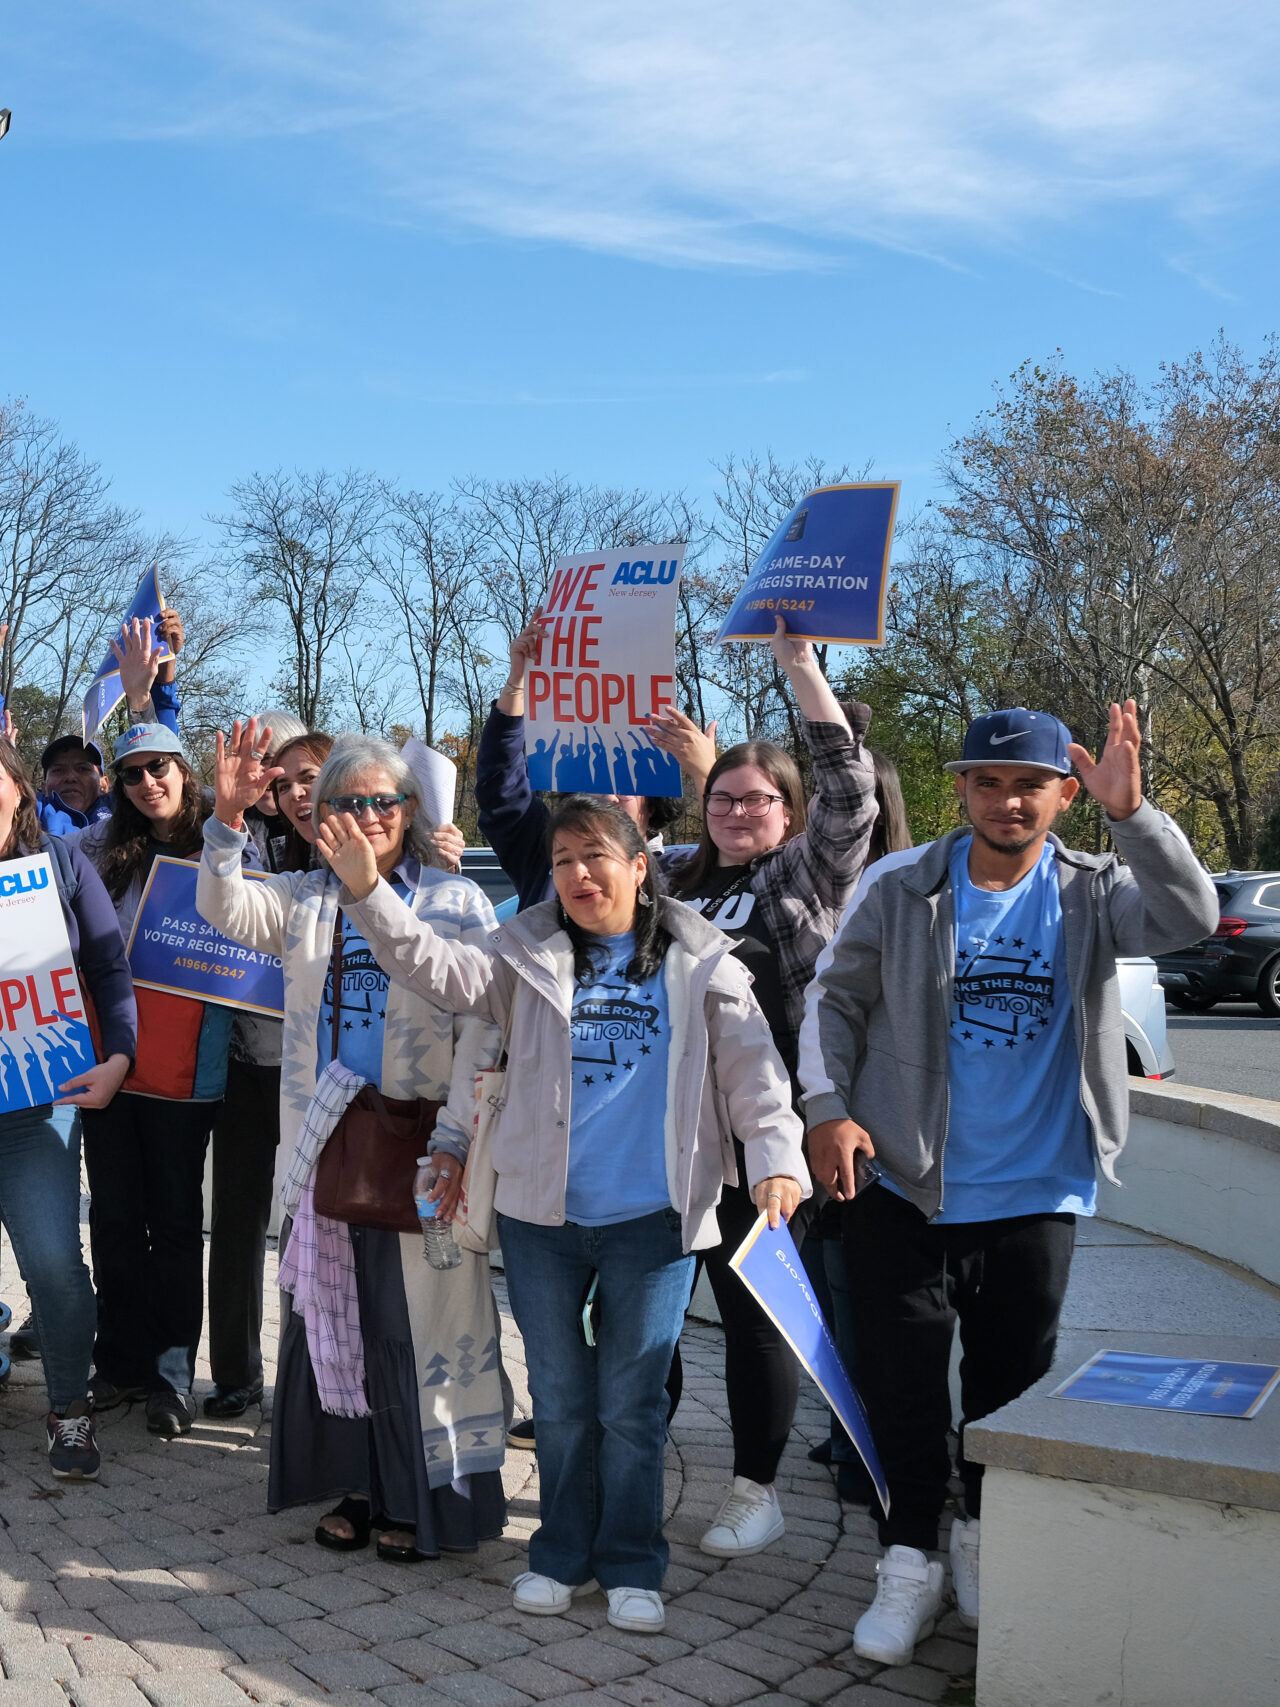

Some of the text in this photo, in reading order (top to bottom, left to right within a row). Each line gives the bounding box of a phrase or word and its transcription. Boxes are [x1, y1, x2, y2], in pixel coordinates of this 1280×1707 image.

[768, 555, 846, 571] SAME-DAY
[611, 560, 678, 586] ACLU
[757, 574, 869, 590] REGISTRATION
[546, 563, 606, 613] WE
[608, 587, 658, 598] New Jersey
[745, 598, 816, 612] A1966/S247
[534, 616, 603, 668] THE
[529, 670, 673, 726] PEOPLE
[723, 876, 748, 896] DIGIT
[6, 894, 36, 908] Jersey
[161, 916, 197, 934] PASS
[144, 929, 283, 968] VOTER REGISTRATIO
[173, 956, 246, 980] A1966/S247
[346, 954, 368, 966] THE
[326, 972, 391, 992] TION
[954, 978, 1052, 995] AKE THE ROAD
[582, 1004, 610, 1015] THE
[612, 1005, 651, 1019] ROAD
[570, 1020, 645, 1041] TION
